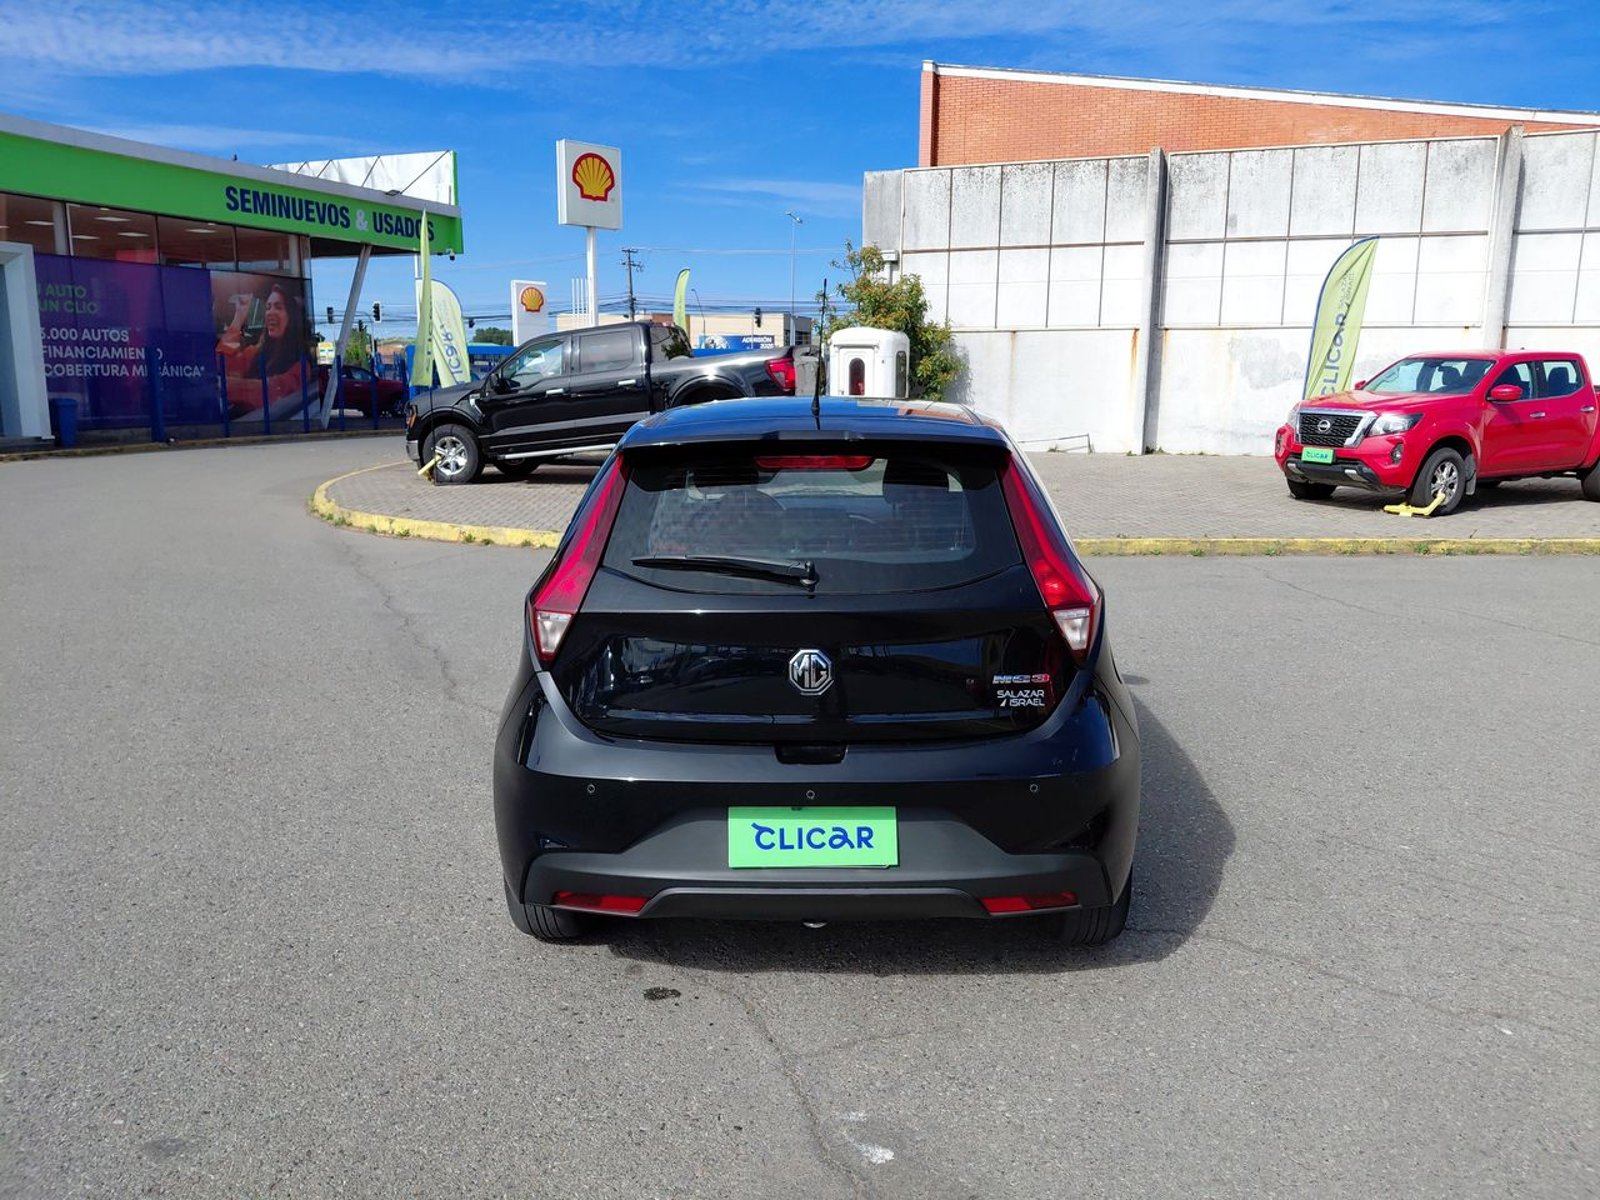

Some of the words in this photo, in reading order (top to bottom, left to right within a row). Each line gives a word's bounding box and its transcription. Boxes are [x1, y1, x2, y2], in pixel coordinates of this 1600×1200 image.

[225, 185, 350, 229] SEMINUEVOS
[355, 208, 368, 232] &
[45, 284, 87, 299] AUTO
[81, 328, 130, 343] AUTOS
[44, 362, 130, 378] COBERTURA
[793, 653, 828, 689] MG
[996, 689, 1045, 699] SALAZAR
[1009, 698, 1046, 707] ISRAEL
